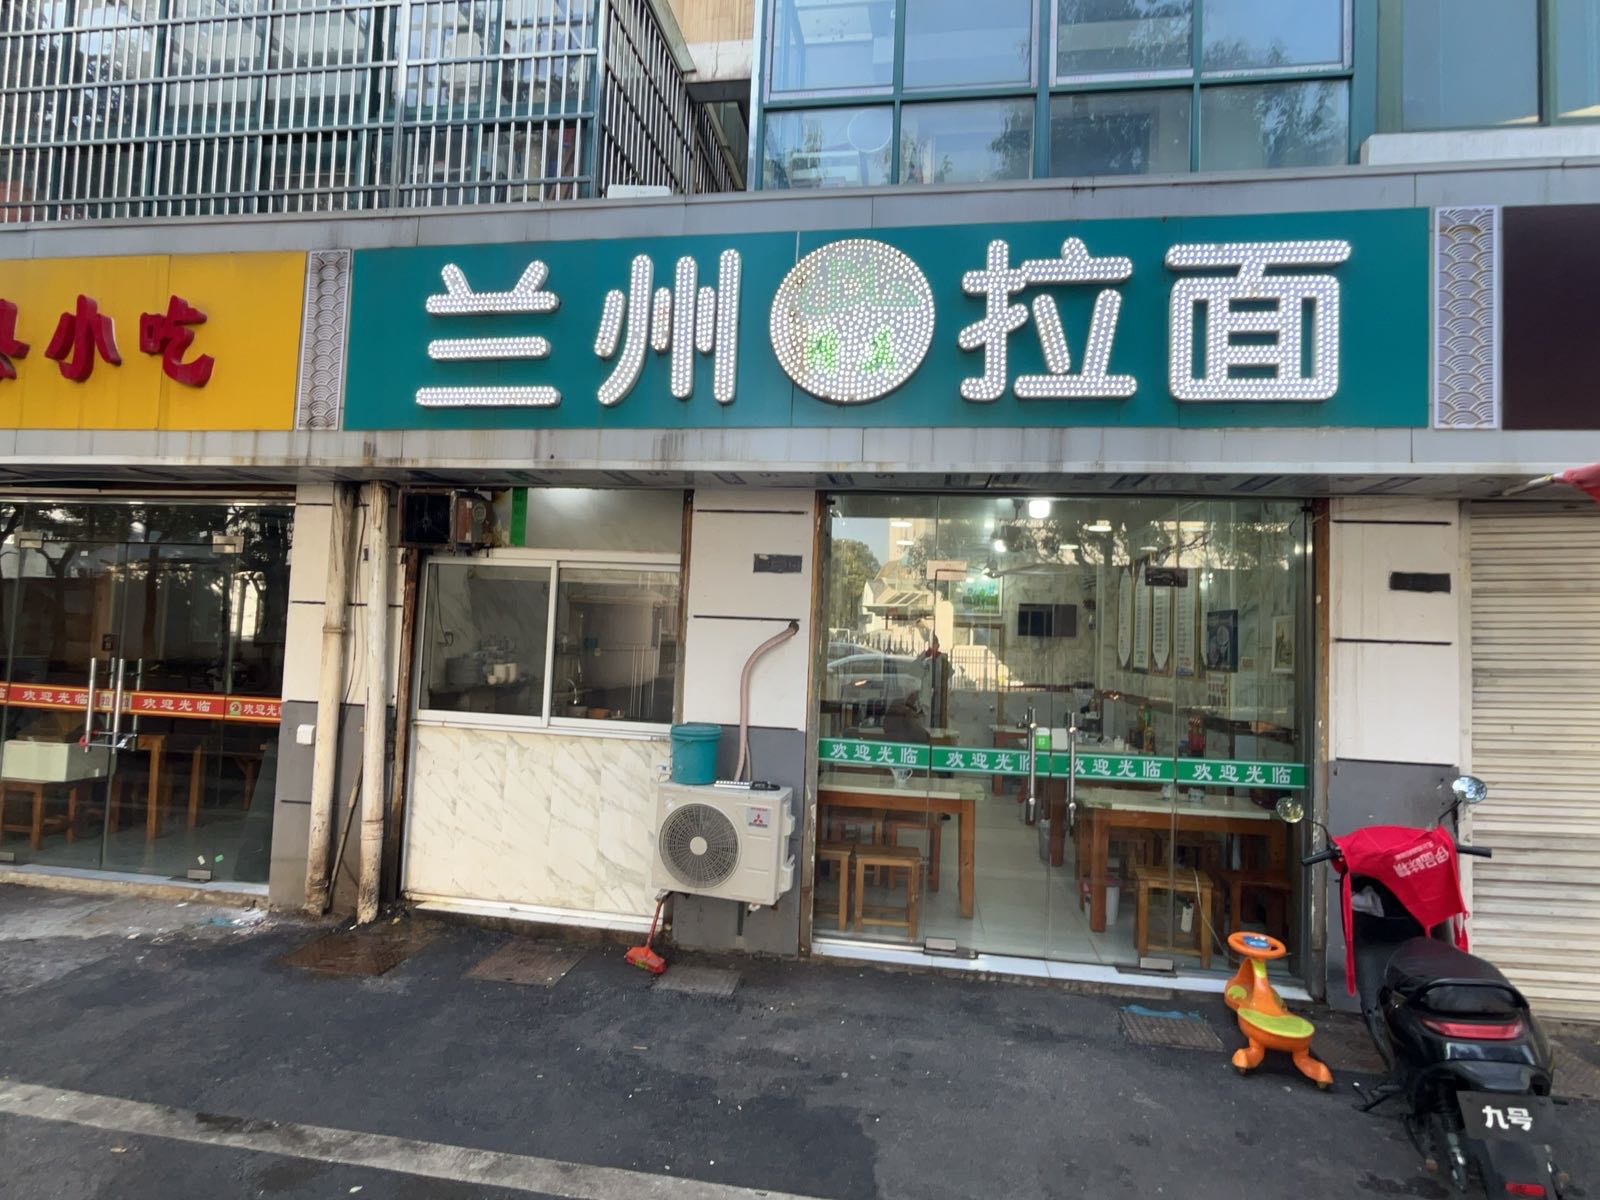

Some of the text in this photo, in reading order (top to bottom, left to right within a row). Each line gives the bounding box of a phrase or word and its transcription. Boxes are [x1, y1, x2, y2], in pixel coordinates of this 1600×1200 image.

[415, 236, 1352, 406] 兰州 拉面
[22, 689, 89, 705] 欢迎光临
[143, 697, 211, 713] 欢迎光临
[243, 703, 282, 717] 欢迎光
[830, 743, 918, 765] 欢迎光临
[1192, 763, 1292, 785] 欢迎光临
[1482, 1105, 1533, 1131] 九号
